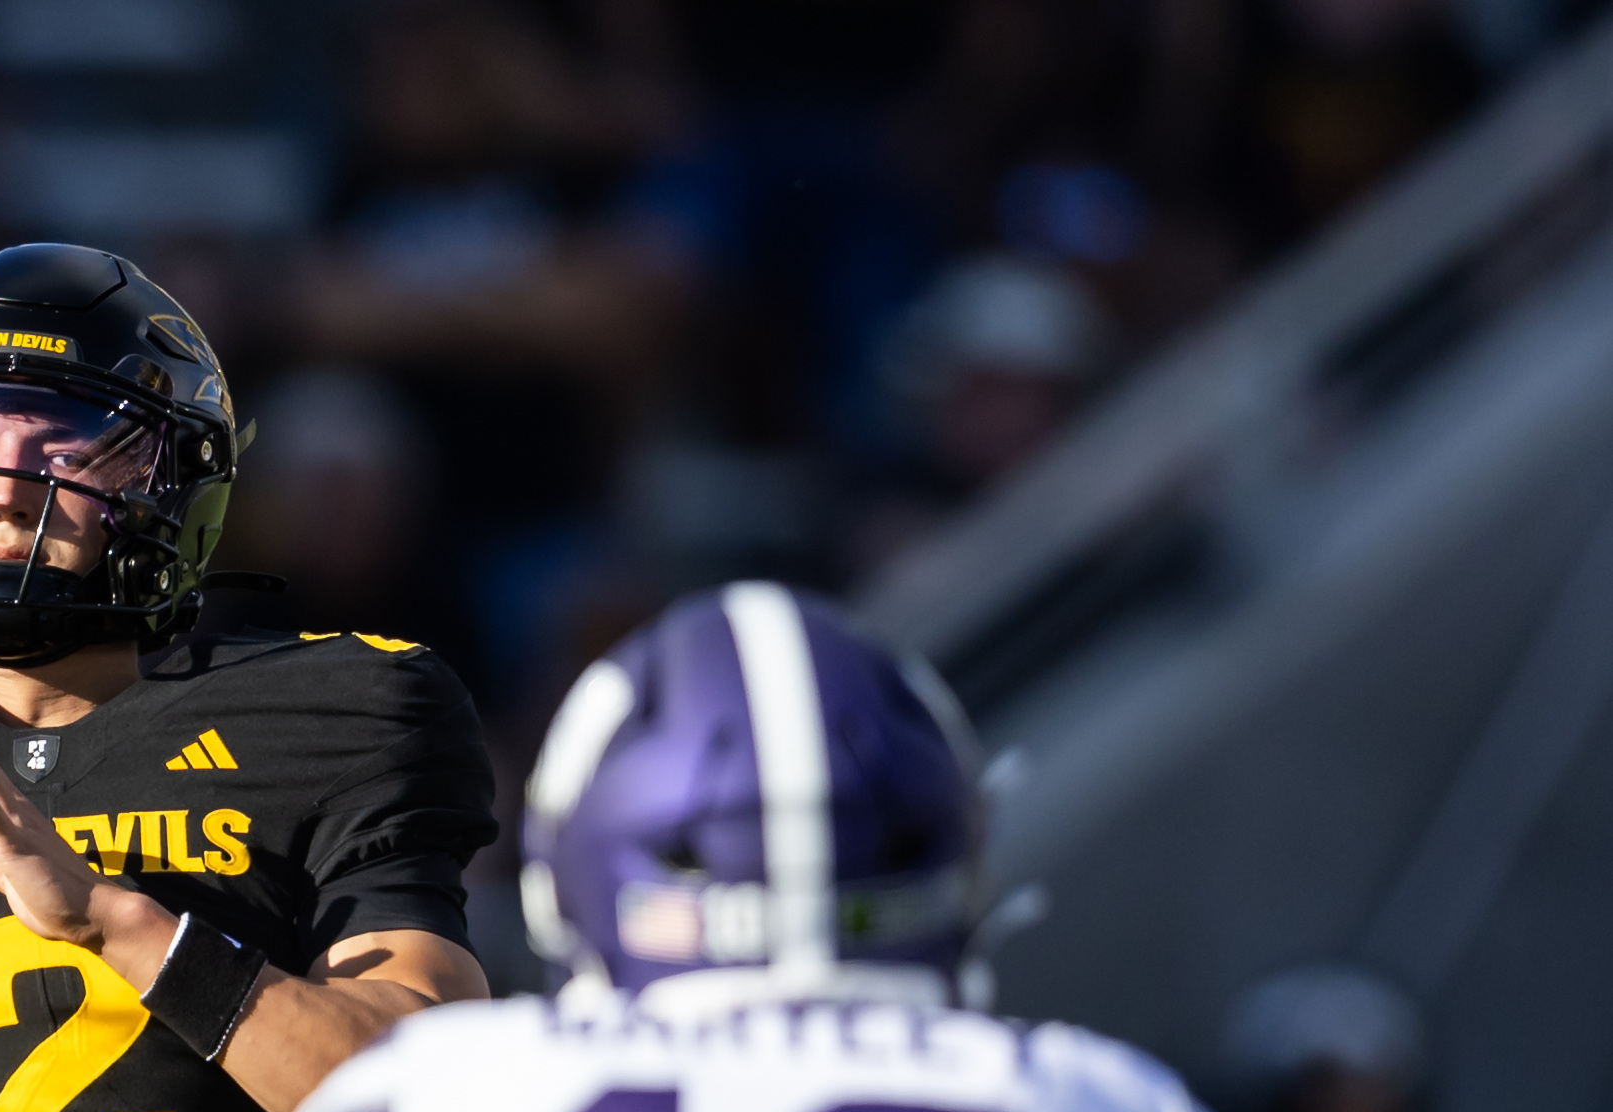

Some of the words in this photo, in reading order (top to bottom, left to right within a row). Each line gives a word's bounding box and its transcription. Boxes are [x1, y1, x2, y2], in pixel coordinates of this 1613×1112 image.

[11, 333, 67, 354] DEVILS
[28, 740, 47, 753] PT
[27, 756, 46, 770] 42
[51, 808, 252, 877] EVILS
